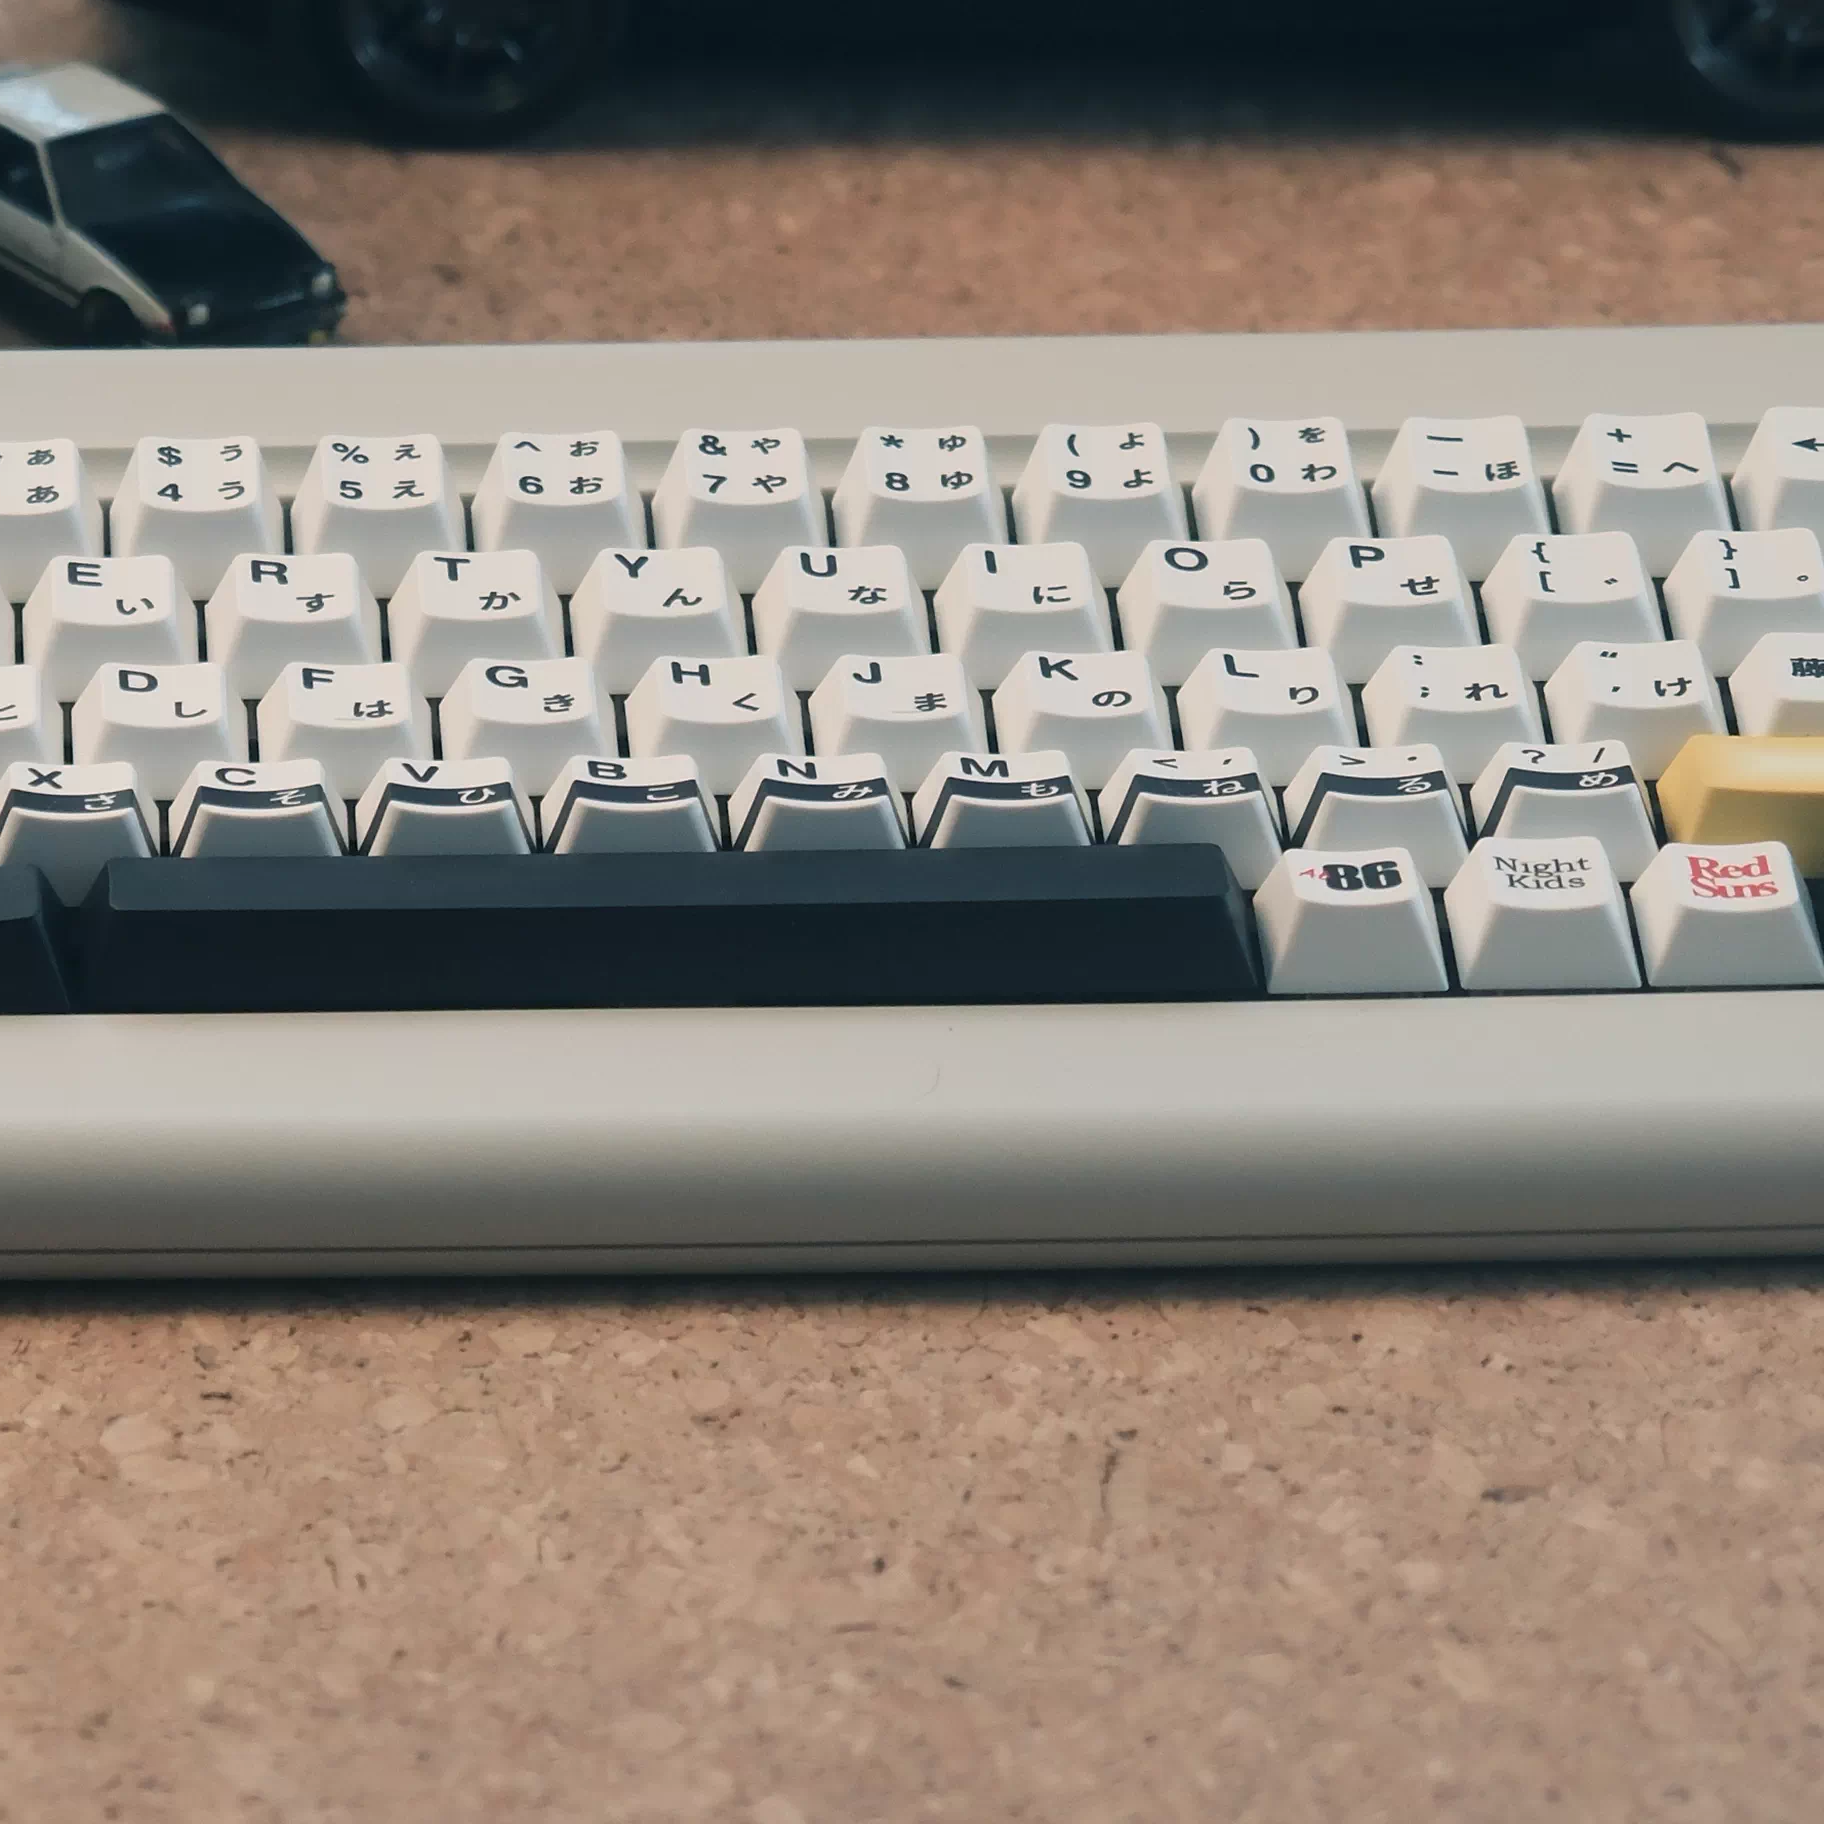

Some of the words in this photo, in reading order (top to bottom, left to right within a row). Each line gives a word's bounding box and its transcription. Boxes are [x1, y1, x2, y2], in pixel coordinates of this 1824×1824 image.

[698, 434, 728, 457] &
[1068, 434, 1079, 456] (
[1247, 427, 1261, 450] )
[1298, 427, 1326, 444] を
[1606, 428, 1632, 443] +
[157, 445, 183, 468] $
[331, 442, 370, 464] %
[1249, 463, 1275, 483] 0
[1301, 463, 1337, 483] わ
[1485, 460, 1521, 482] ほ
[1612, 462, 1638, 473] =
[1663, 462, 1698, 472] へ
[518, 475, 544, 495] 6
[569, 476, 604, 495] お
[702, 474, 728, 494] 7
[751, 474, 787, 494] や
[885, 472, 910, 492] 8
[940, 470, 974, 490] ゆ
[1066, 469, 1092, 489] 9
[1123, 468, 1154, 489] よ
[26, 485, 60, 504] あ
[157, 483, 183, 502] 4
[218, 480, 245, 501] う
[339, 480, 363, 500] 5
[392, 479, 425, 499] え
[1164, 547, 1209, 572] O
[1349, 544, 1385, 569] P
[1531, 541, 1550, 564] {
[1718, 538, 1738, 561] }
[250, 559, 289, 585] R
[433, 556, 471, 582] T
[614, 553, 649, 579] Y
[799, 552, 838, 578] U
[984, 550, 998, 574] I
[67, 561, 103, 587] E
[1538, 570, 1556, 593] [
[1724, 567, 1741, 589] ]
[847, 585, 887, 605] な
[1032, 585, 1071, 605] に
[1223, 581, 1257, 601] ら
[1399, 575, 1440, 596] せ
[115, 597, 155, 616] い
[295, 593, 335, 613] す
[478, 591, 521, 611] か
[662, 587, 703, 608] ん
[670, 661, 711, 686] H
[852, 661, 882, 684] J
[1038, 656, 1079, 681] K
[1223, 653, 1260, 678] L
[118, 669, 159, 693] D
[301, 667, 335, 690] F
[485, 665, 529, 689] G
[1654, 677, 1693, 697] け
[732, 692, 760, 712] く
[914, 692, 948, 712] ま
[1091, 690, 1132, 707] の
[1289, 686, 1319, 705] り
[1463, 682, 1509, 702] れ
[174, 701, 208, 719] し
[353, 699, 394, 719] は
[543, 694, 575, 713] き
[1153, 759, 1177, 768] <
[1340, 755, 1365, 765] >
[1521, 749, 1546, 764] ?
[1592, 747, 1606, 764] /
[215, 767, 257, 787] C
[401, 762, 440, 783] V
[587, 760, 628, 780] B
[776, 758, 818, 780] N
[960, 757, 1010, 778] M
[27, 767, 63, 790] X
[1203, 780, 1246, 796] ね
[1397, 776, 1432, 793] る
[1579, 771, 1619, 788] め
[270, 789, 306, 805] そ
[457, 787, 496, 804] ひ
[646, 785, 679, 801] こ
[832, 784, 873, 799] み
[1021, 782, 1059, 797] も
[84, 794, 117, 811] さ
[1494, 856, 1590, 878] Night
[1687, 855, 1772, 878] Red
[1506, 873, 1586, 890] Kids
[1690, 876, 1779, 898] Suns
